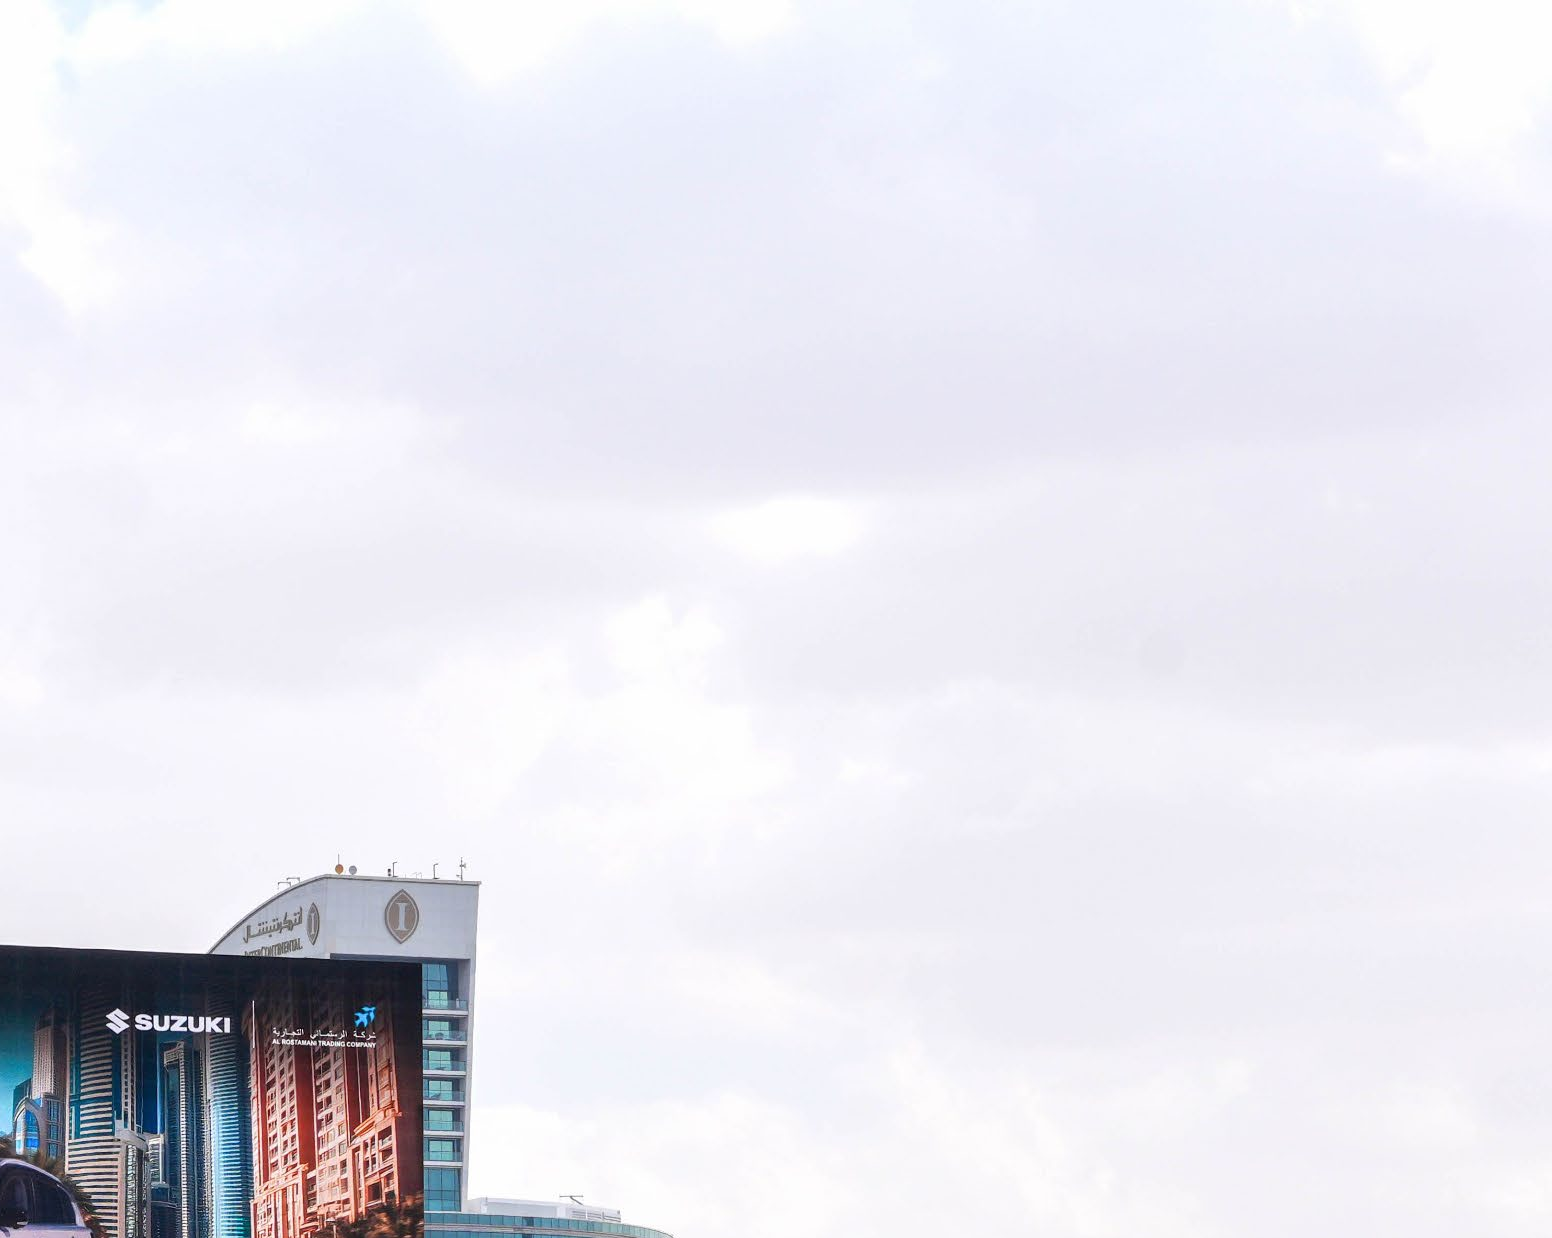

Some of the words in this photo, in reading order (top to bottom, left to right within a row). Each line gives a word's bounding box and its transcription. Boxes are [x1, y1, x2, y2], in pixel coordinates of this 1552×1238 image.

[134, 1012, 231, 1034] SUZUKI
[272, 1027, 304, 1038] التجارية
[353, 1030, 376, 1041] شركة
[281, 1038, 317, 1046] ROSTAMANI
[346, 1041, 376, 1049] COMPANY
